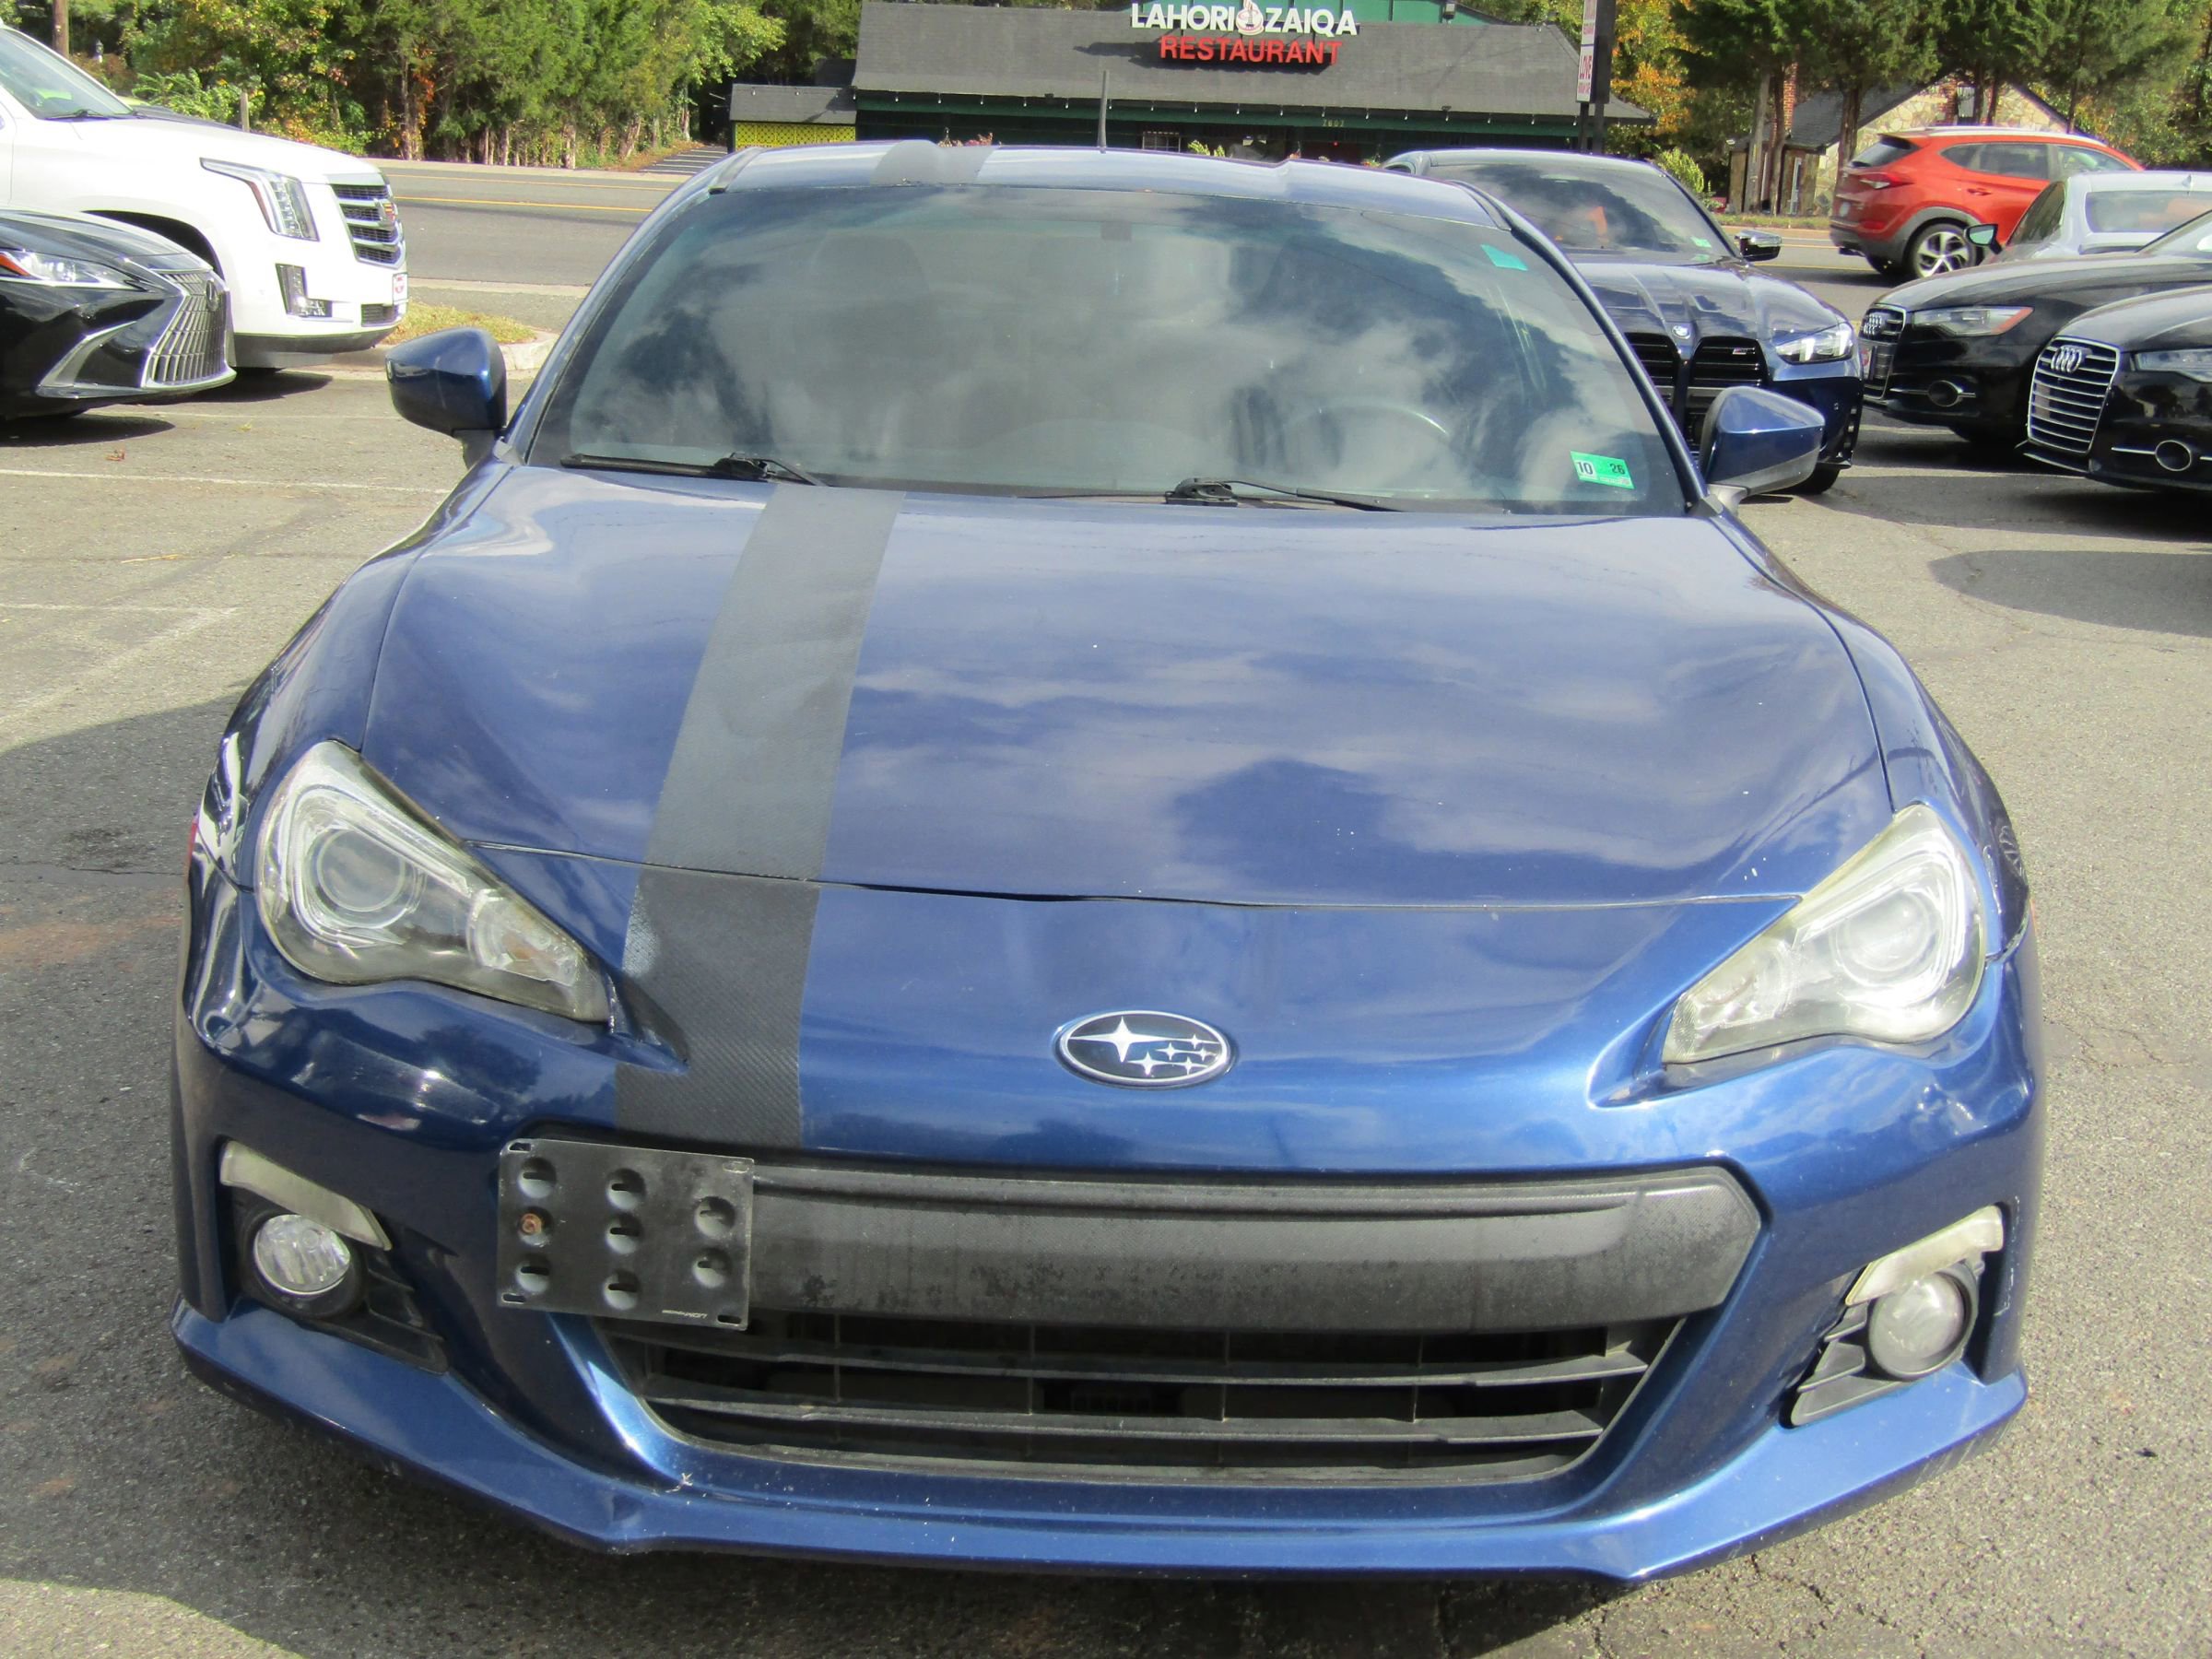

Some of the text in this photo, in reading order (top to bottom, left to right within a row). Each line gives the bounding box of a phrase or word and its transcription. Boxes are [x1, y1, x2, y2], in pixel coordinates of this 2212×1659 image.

[1131, 3, 1358, 37] LAHORI ZAIQA
[1159, 35, 1342, 65] RESTAURANT
[1576, 462, 1594, 475] 10
